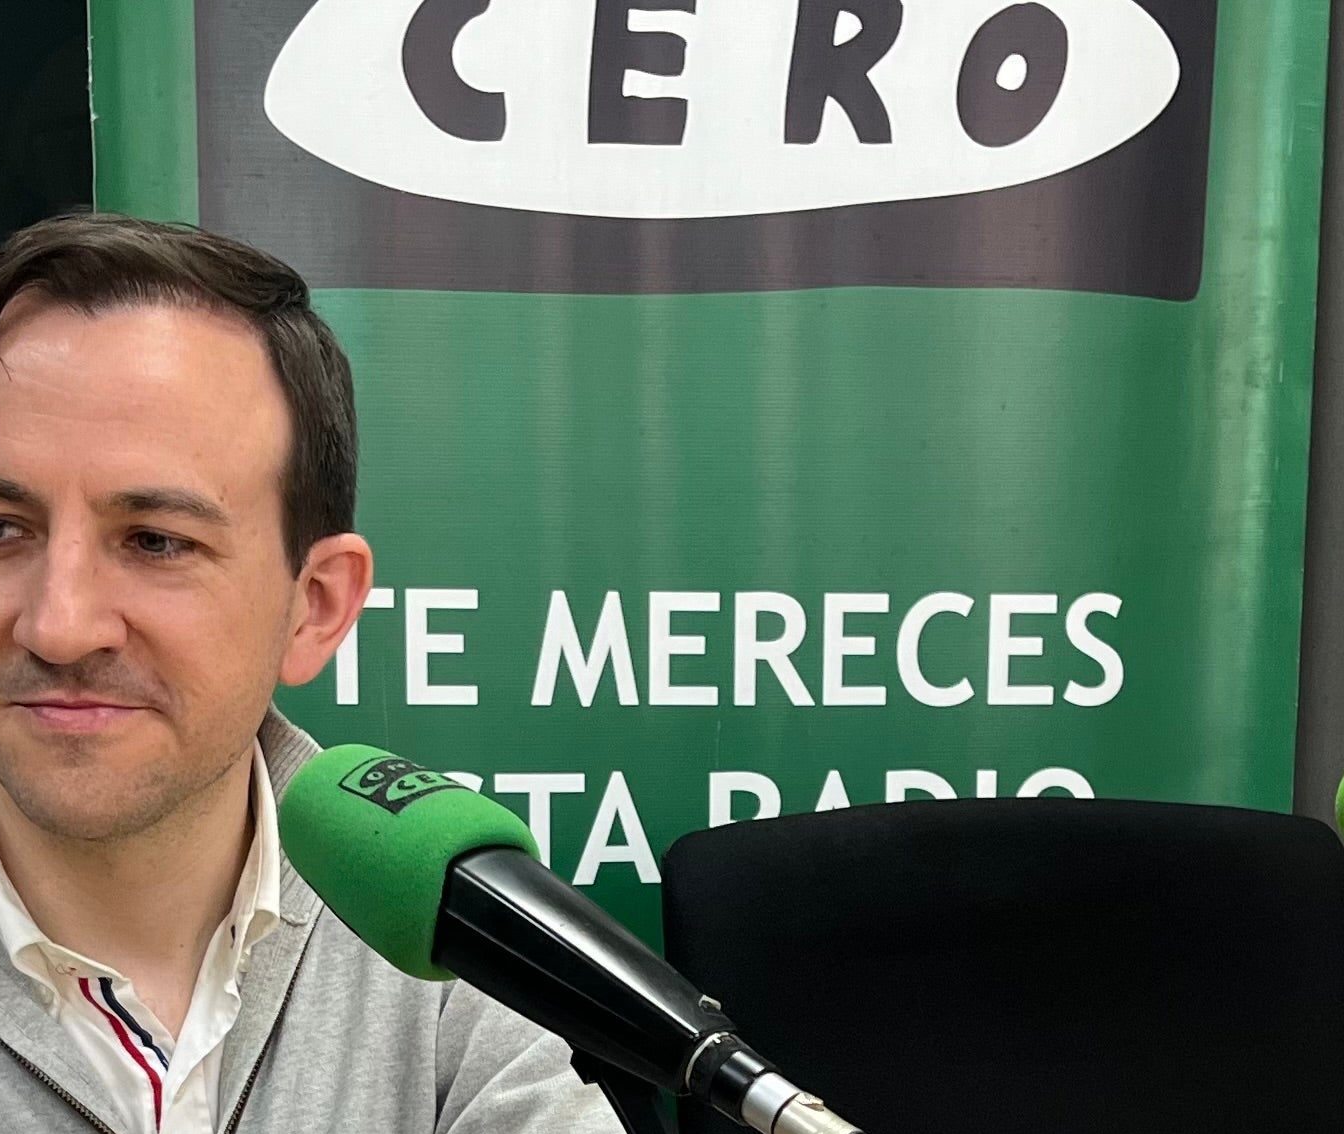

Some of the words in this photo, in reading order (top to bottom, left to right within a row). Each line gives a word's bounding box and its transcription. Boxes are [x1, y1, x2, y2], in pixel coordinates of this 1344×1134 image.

[401, 0, 1069, 148] CERO
[335, 588, 479, 706] TE
[530, 590, 1125, 708] MERECES
